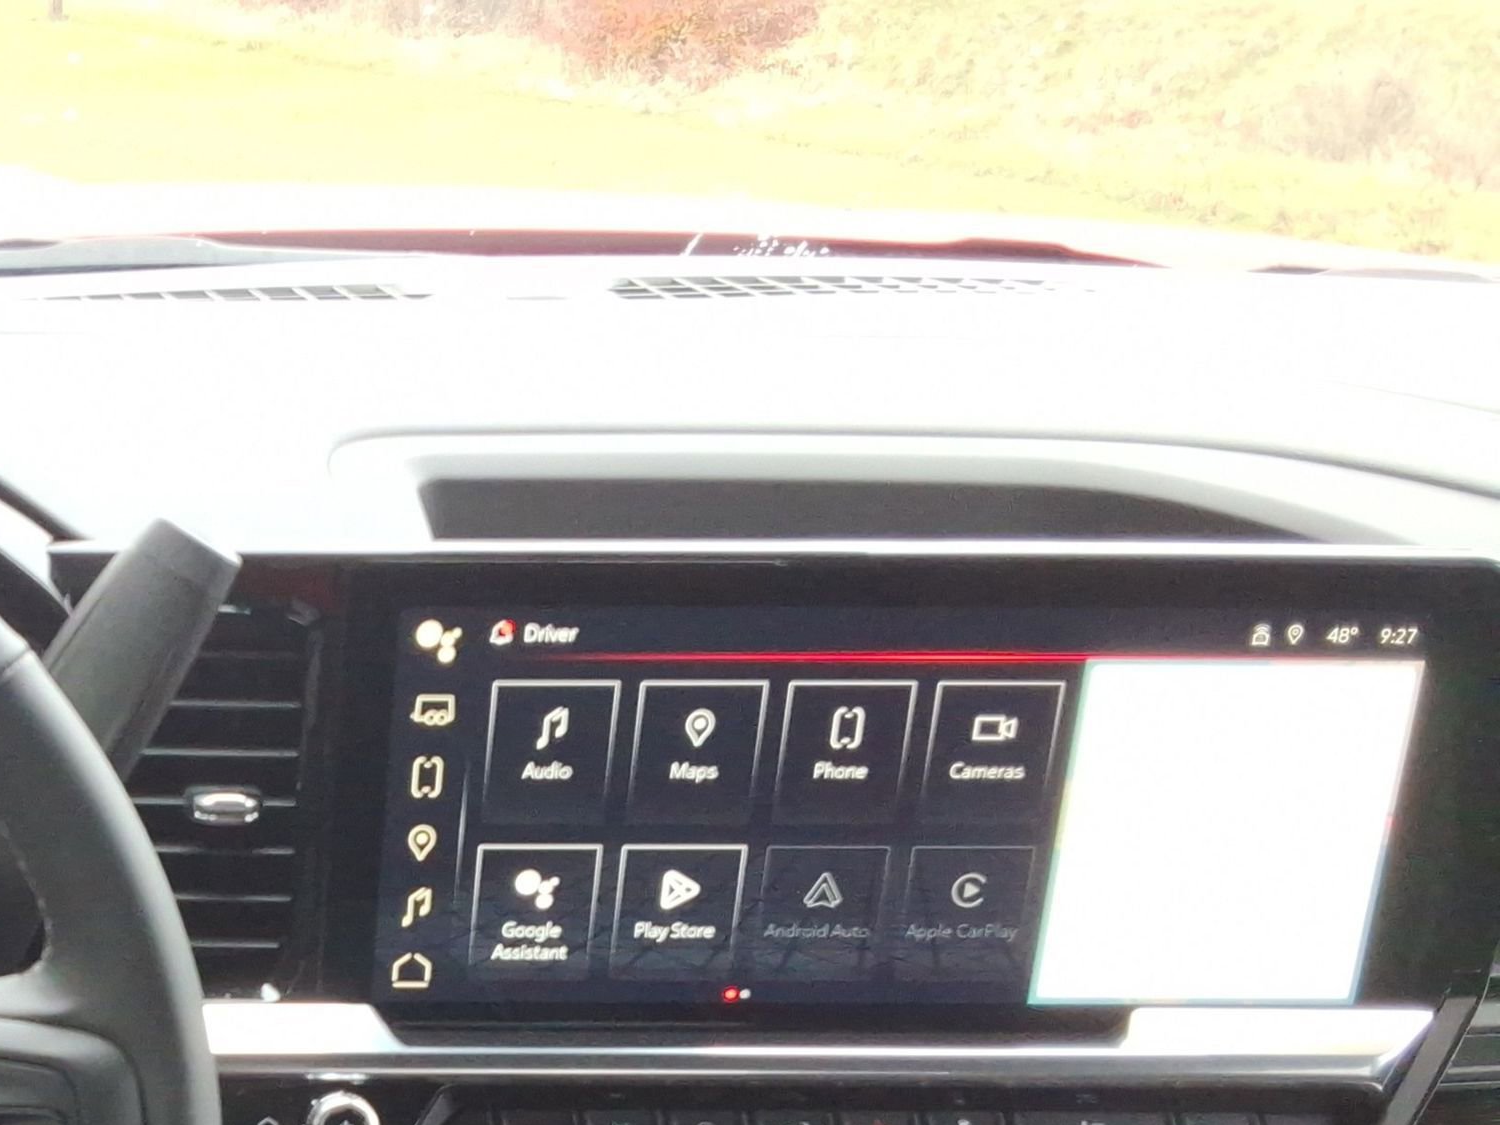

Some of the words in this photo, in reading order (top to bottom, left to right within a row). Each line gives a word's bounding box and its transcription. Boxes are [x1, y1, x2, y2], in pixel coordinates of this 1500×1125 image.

[524, 623, 579, 643] Driver
[1380, 627, 1418, 644] 9:27
[522, 762, 573, 780] Audio
[669, 762, 719, 783] Maps
[813, 761, 868, 780] Phone
[949, 762, 1026, 780] Cameras
[501, 922, 562, 942] Google
[634, 922, 670, 943] Play
[671, 922, 716, 939] Store
[764, 923, 829, 938] Android
[831, 924, 868, 938] Auto
[905, 924, 953, 940] Apple
[956, 924, 1019, 941] CarPlay
[491, 945, 568, 961] Assistant
